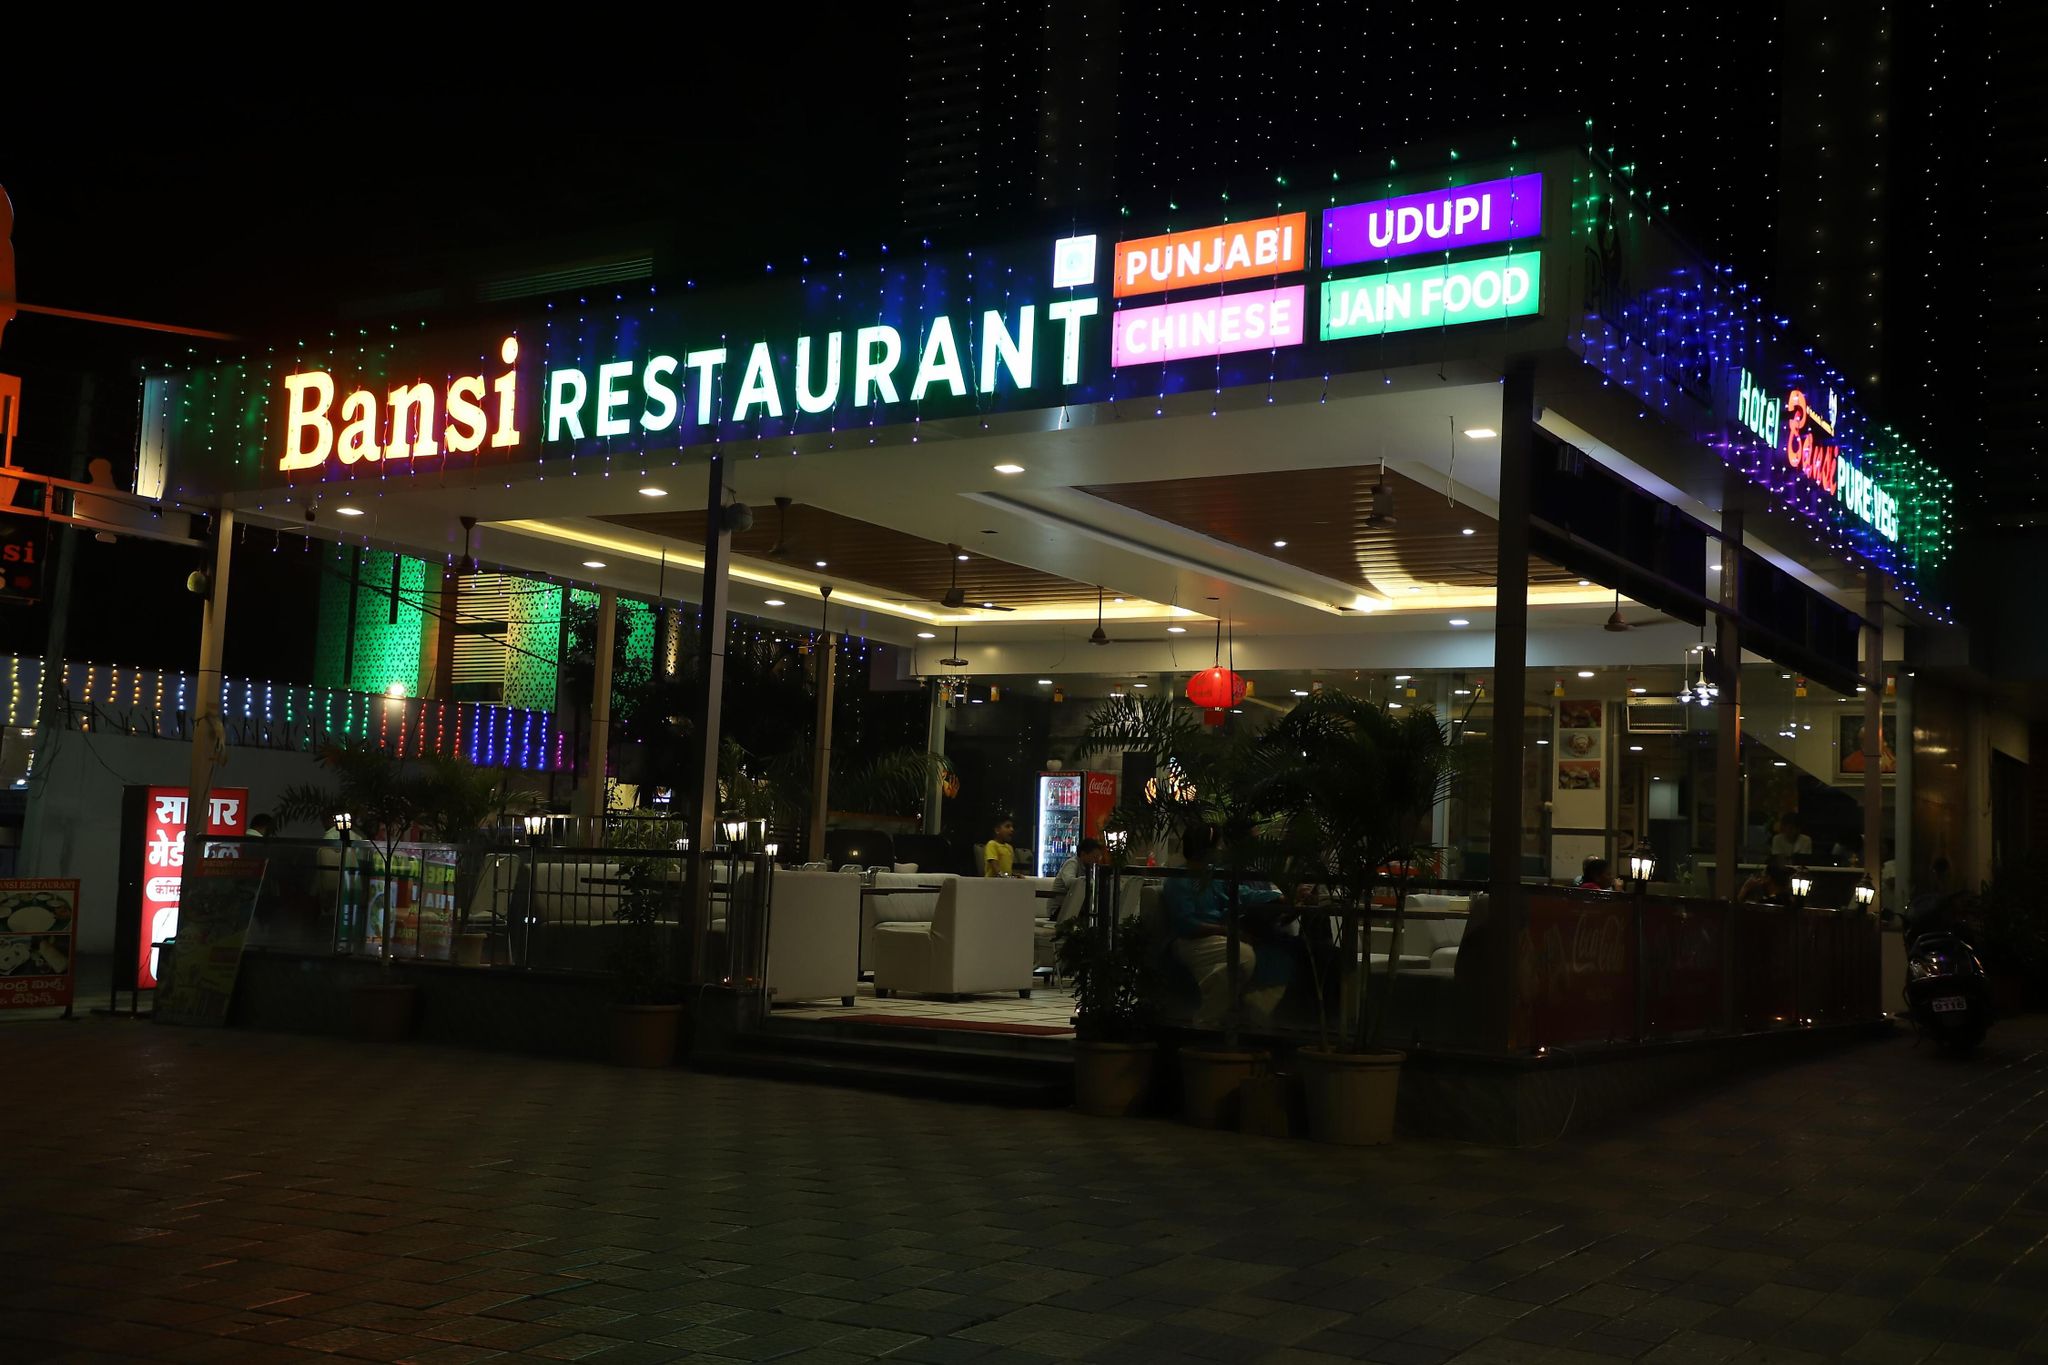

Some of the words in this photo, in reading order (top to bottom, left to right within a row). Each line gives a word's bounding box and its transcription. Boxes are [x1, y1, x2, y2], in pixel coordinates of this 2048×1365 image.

[1368, 193, 1492, 249] UDUPI
[1125, 225, 1294, 287] PUNJABI
[1124, 298, 1292, 354] CHINESE
[1332, 283, 1413, 328] JAIN
[1422, 264, 1531, 314] FOOD
[279, 336, 520, 471] Bansi
[546, 298, 1101, 442] RESTAURANT
[1738, 367, 1780, 449] Hotel
[1837, 454, 1874, 524] PURE
[1872, 483, 1899, 543] VEG
[20, 879, 75, 890] RESTAURANT
